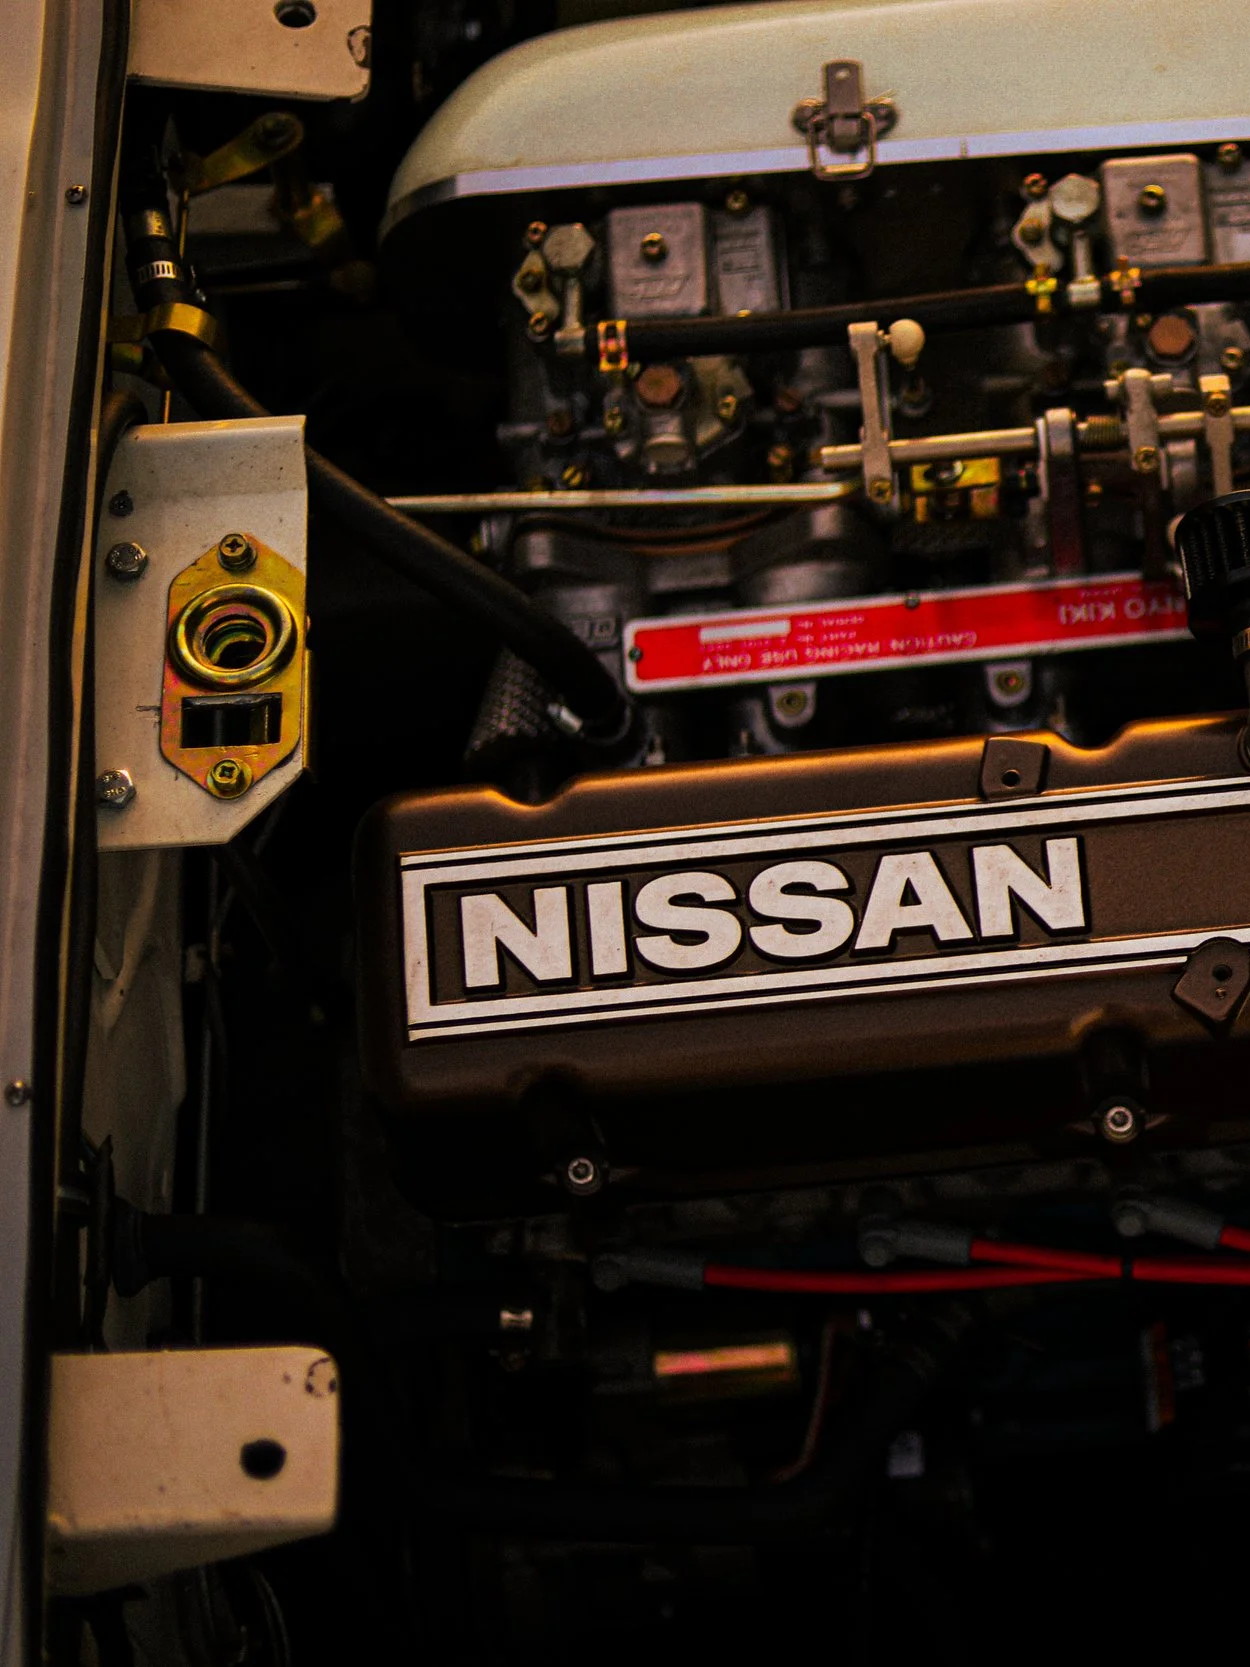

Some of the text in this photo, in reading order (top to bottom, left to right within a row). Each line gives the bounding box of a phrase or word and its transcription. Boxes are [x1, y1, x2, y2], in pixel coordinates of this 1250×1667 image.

[1058, 601, 1117, 626] KIKI
[804, 640, 880, 663] RACING
[890, 630, 978, 651] CAUTION
[700, 653, 752, 673] ONLY
[759, 647, 799, 666] USE
[460, 837, 1085, 990] NISSAN
